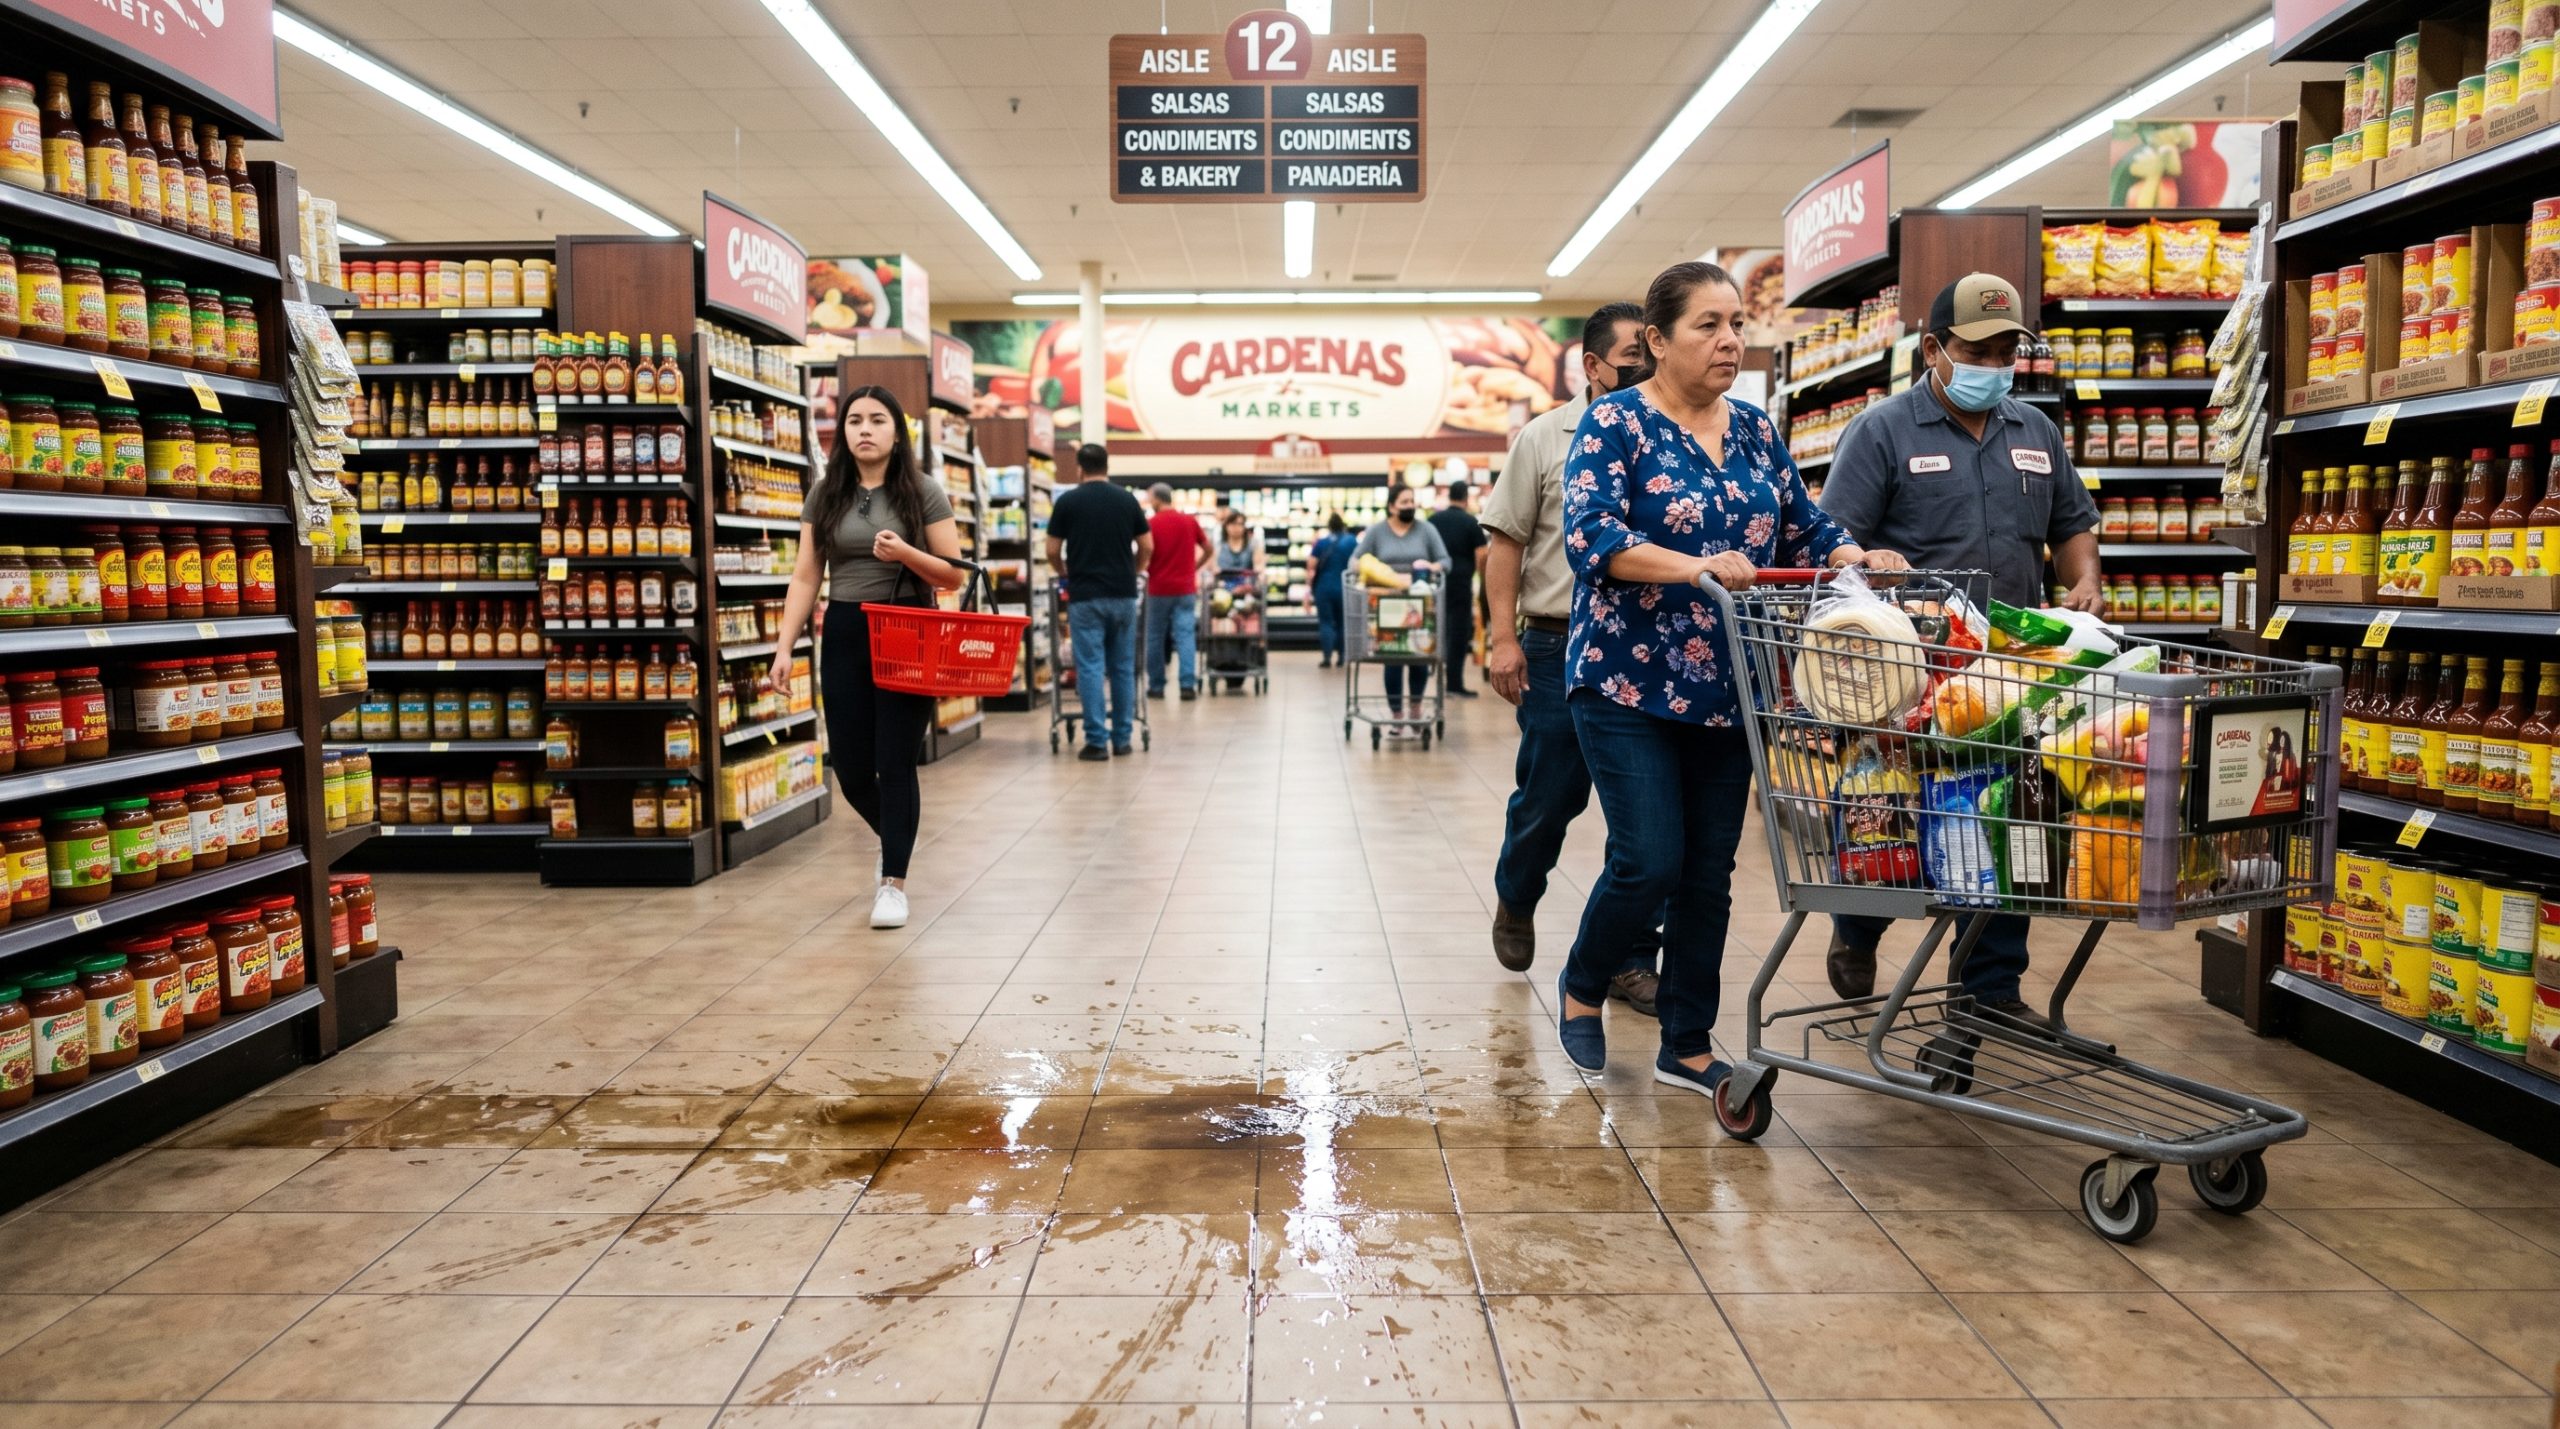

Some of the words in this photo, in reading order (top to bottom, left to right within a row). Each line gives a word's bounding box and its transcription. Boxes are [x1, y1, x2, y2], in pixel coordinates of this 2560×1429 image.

[1238, 21, 1297, 72] 12
[1139, 49, 1210, 73] AISLE
[1327, 49, 1397, 73] AISLE
[1151, 92, 1230, 114] SALSAS
[1306, 92, 1385, 114] SALSAS
[1124, 129, 1258, 151] CONDIMENTS
[1279, 129, 1412, 151] CONDIMENTS
[1140, 166, 1157, 187] &
[1161, 166, 1241, 187] BAKERY
[1288, 161, 1403, 187] PANADERÍA
[1171, 336, 1406, 397] CARDENAS
[1221, 401, 1361, 418] MARKETS
